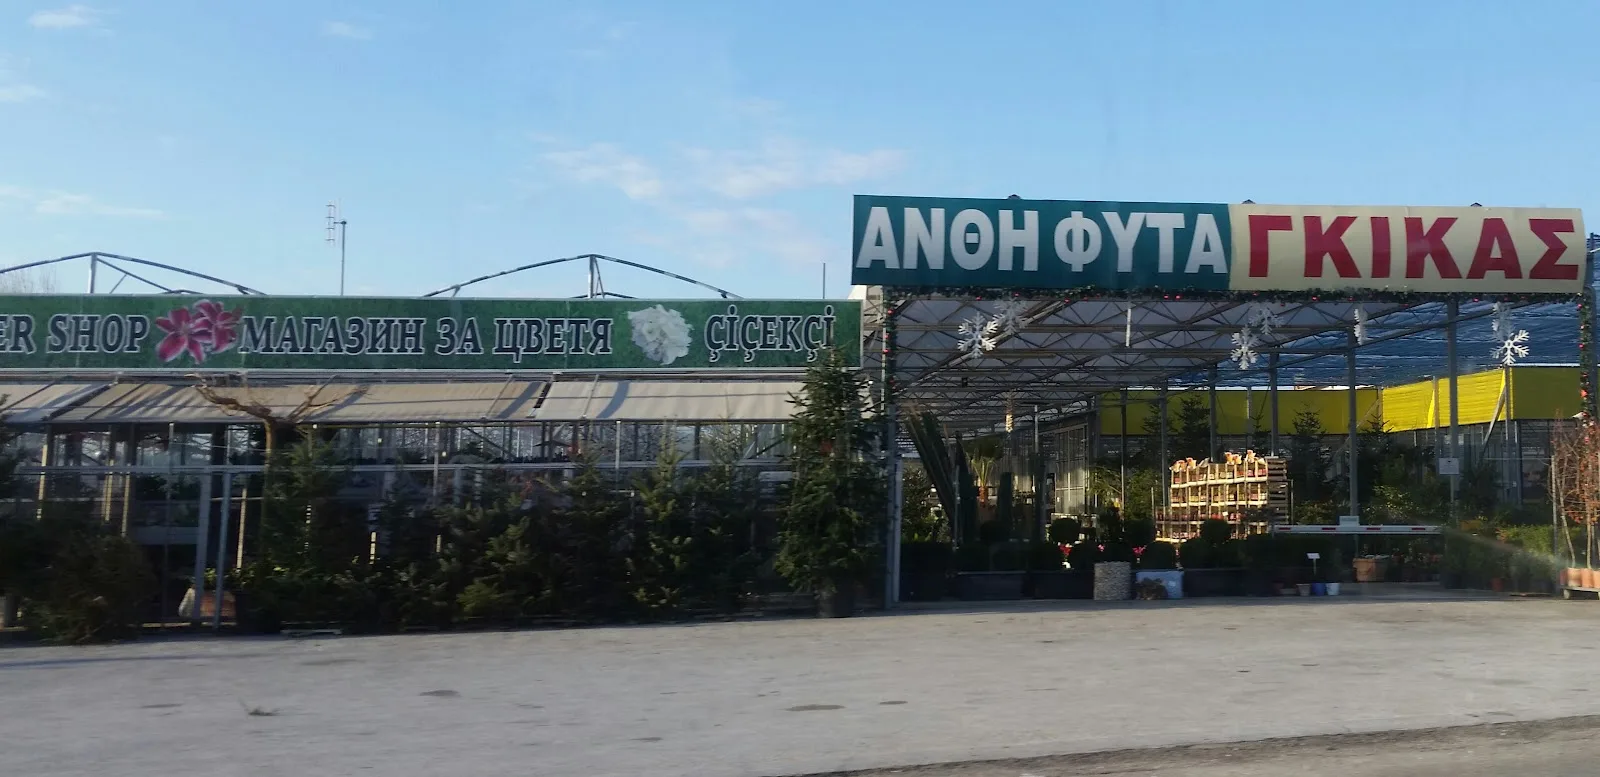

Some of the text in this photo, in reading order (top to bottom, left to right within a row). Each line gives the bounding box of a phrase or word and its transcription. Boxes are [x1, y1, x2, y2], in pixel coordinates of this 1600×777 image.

[855, 206, 1580, 280] ΑΝΘΗ ΦΥΤΑ ΓΚΙΚΑΣ
[46, 314, 150, 354] SHOP
[238, 315, 613, 364] МАГАЗИН ЗА ЦВЕТЯ
